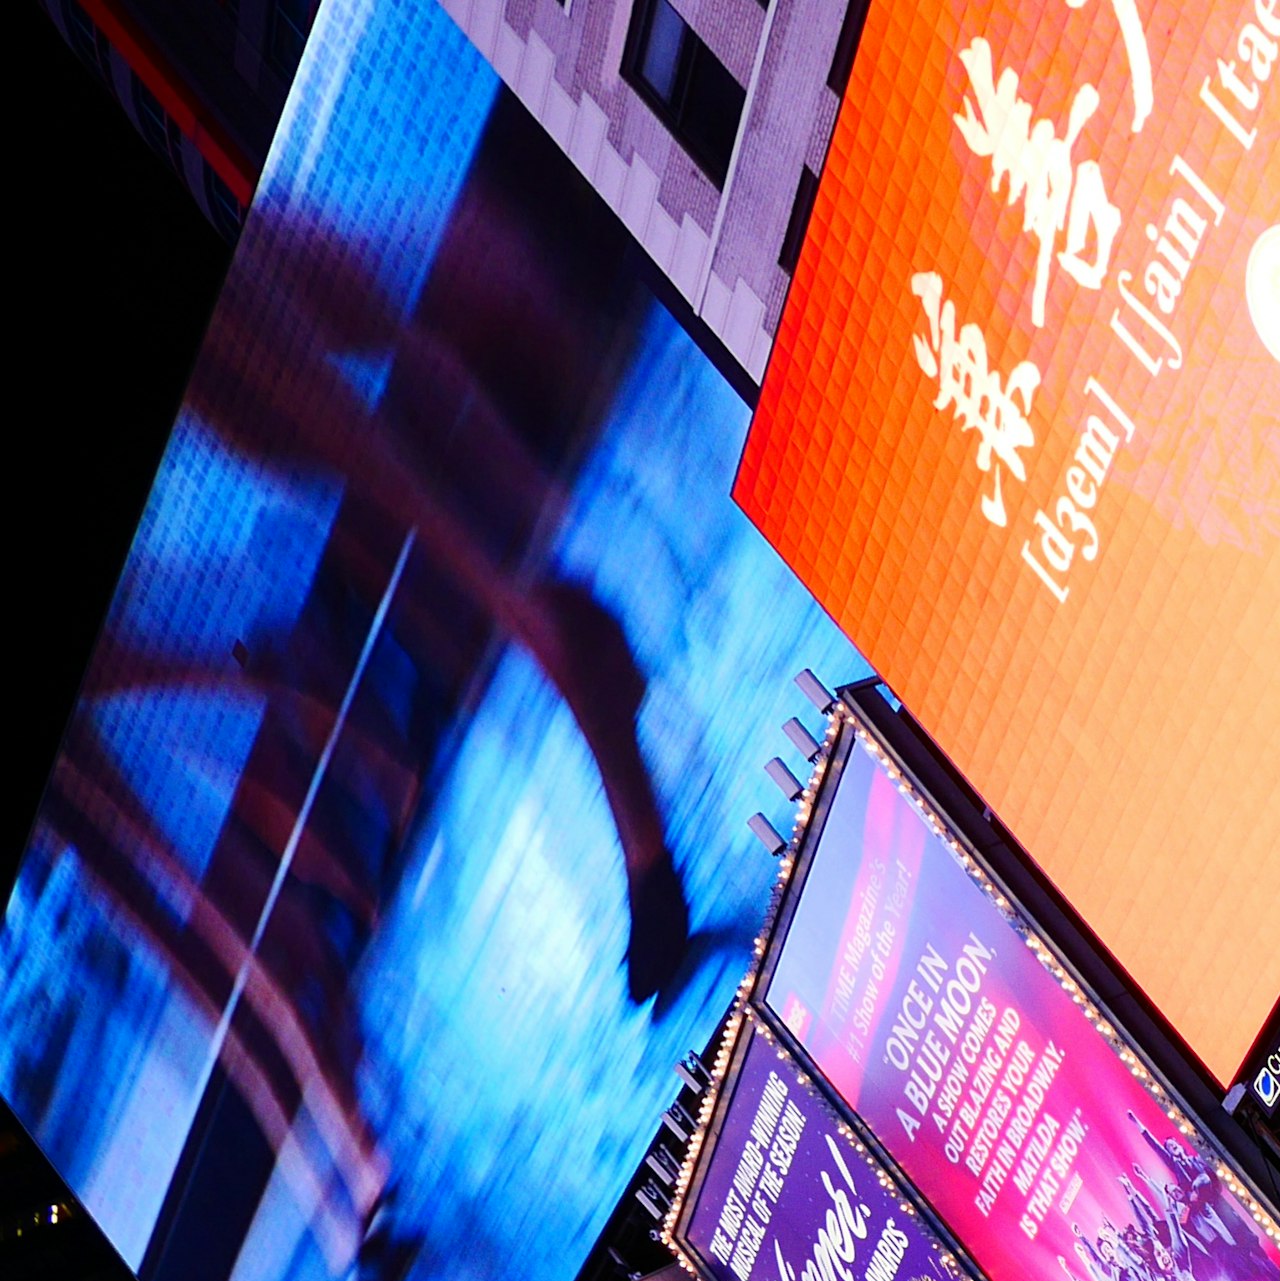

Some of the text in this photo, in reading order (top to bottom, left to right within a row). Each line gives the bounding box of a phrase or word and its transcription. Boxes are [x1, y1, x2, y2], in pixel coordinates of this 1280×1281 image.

[854, 977, 883, 1036] Show
[873, 918, 898, 957] the
[916, 942, 949, 993] IN
[896, 931, 992, 1142] A BLUE MOON,
[931, 996, 997, 1133] A SHOW COMES
[944, 1007, 1021, 1164] OUT BLAZING AND
[772, 1099, 807, 1176] SEASON!
[965, 1040, 1036, 1176] RESTORES YOUR
[974, 1040, 1065, 1217] FAITH IN BROADWAY.
[1012, 1113, 1060, 1195] MATILDA
[709, 1070, 789, 1266] THE MOST AWARD-WINNING
[753, 1190, 775, 1224] OF
[762, 1163, 784, 1202] THE
[1021, 1167, 1060, 1240] IS THAT
